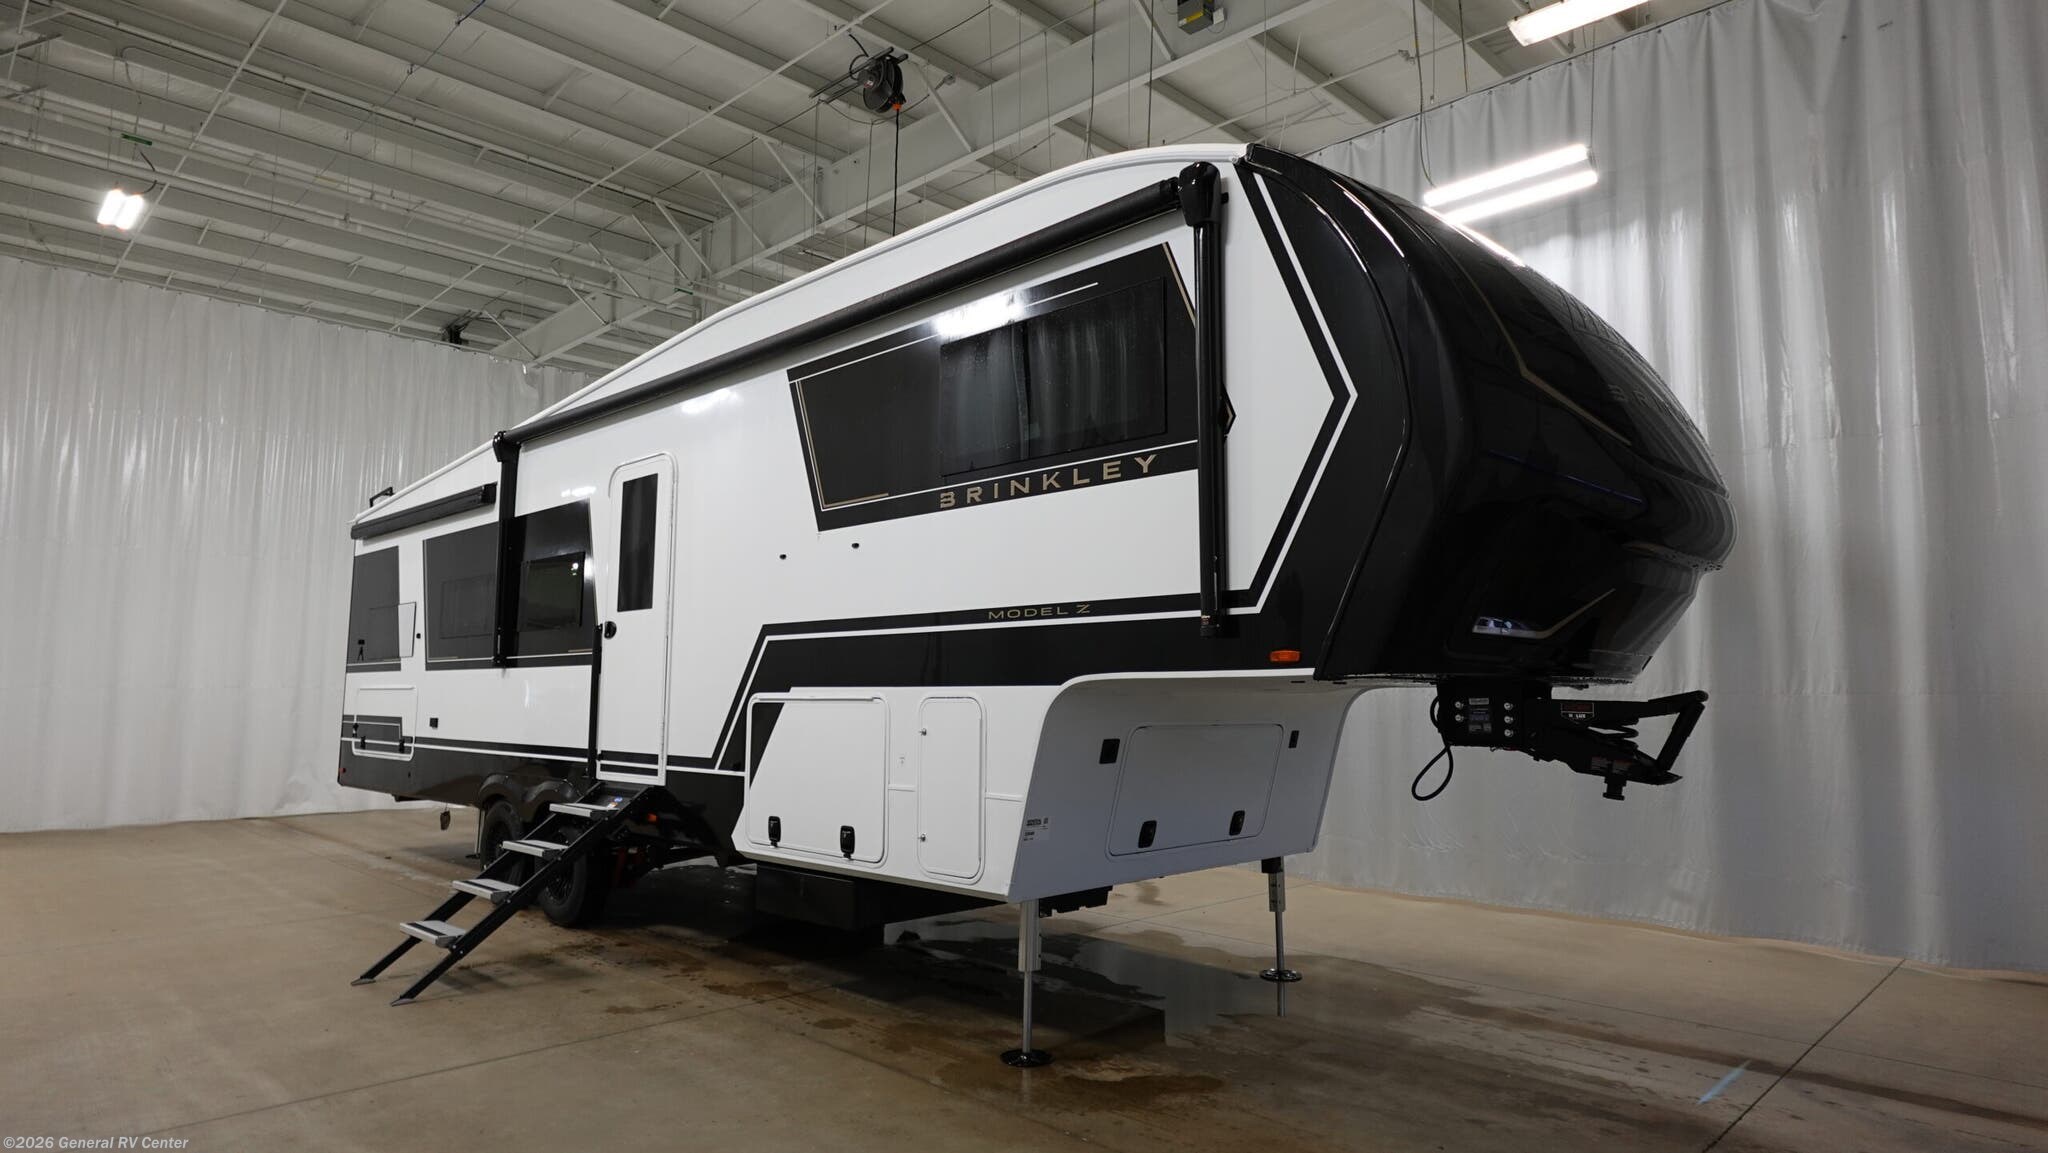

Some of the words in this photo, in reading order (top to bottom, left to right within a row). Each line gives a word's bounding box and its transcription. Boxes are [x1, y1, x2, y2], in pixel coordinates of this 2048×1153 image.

[940, 454, 1157, 509] BRINKLEY
[988, 606, 1069, 620] MODEL
[1076, 604, 1091, 615] Z
